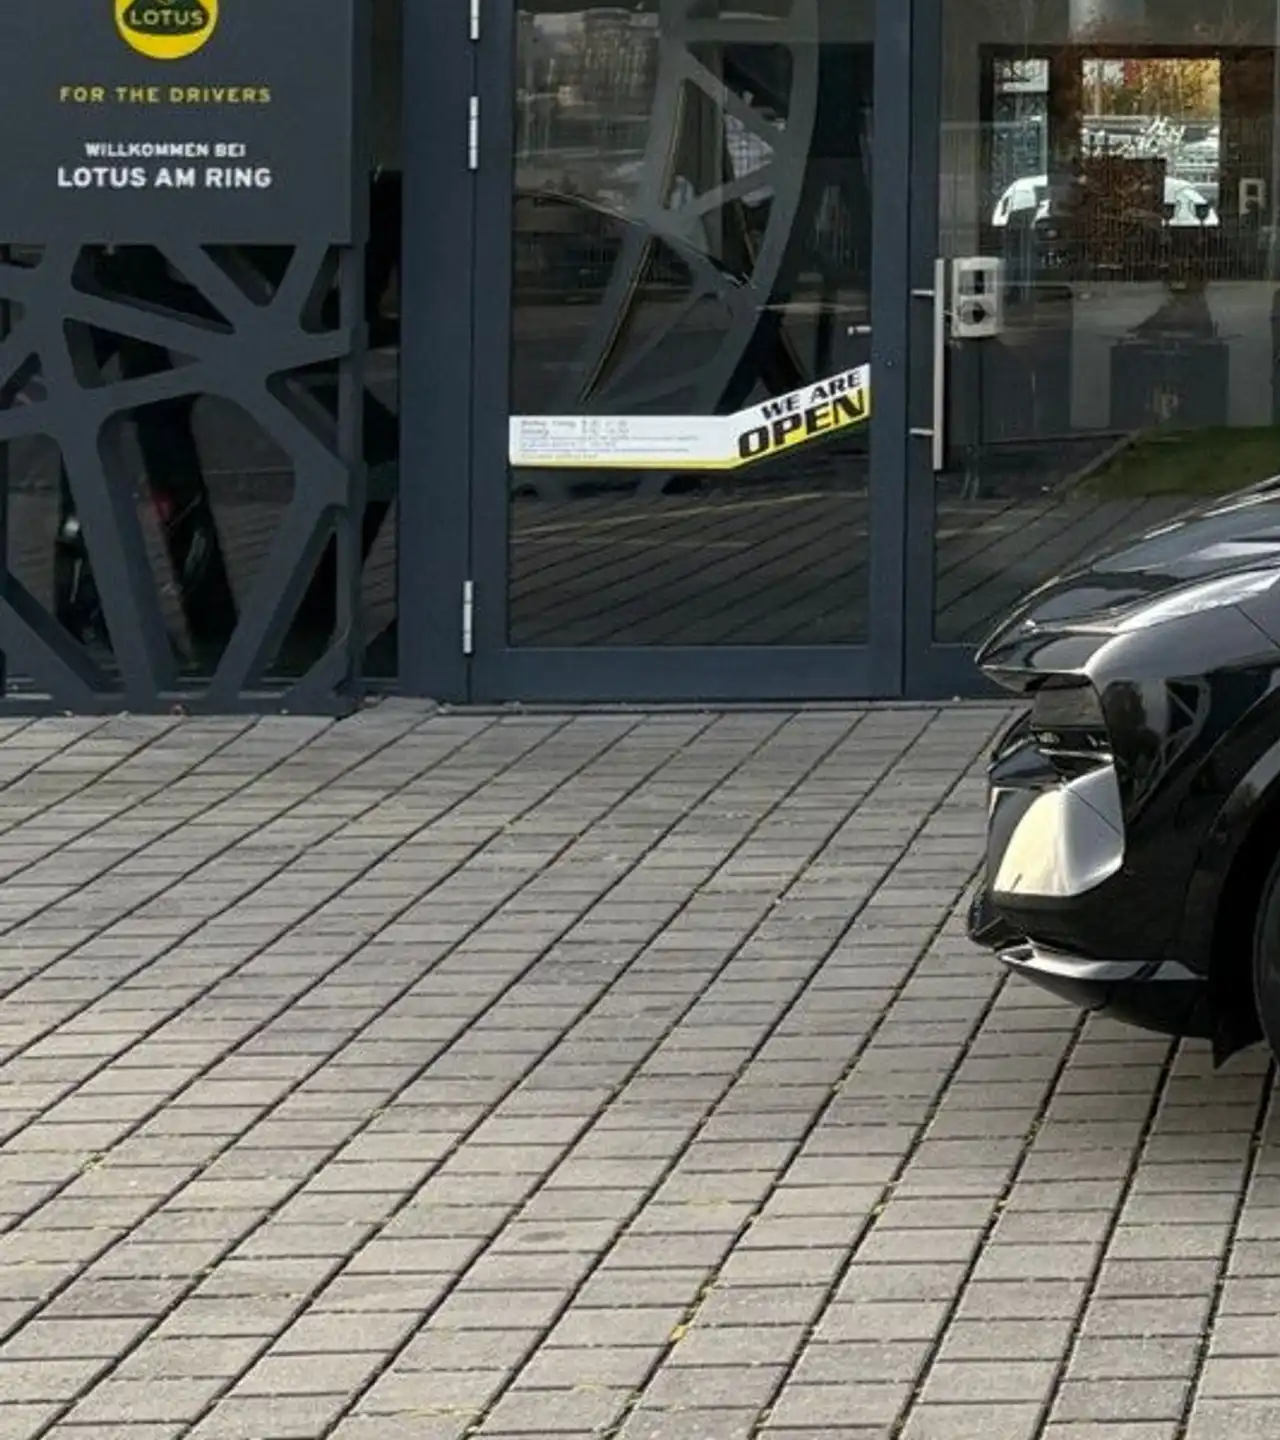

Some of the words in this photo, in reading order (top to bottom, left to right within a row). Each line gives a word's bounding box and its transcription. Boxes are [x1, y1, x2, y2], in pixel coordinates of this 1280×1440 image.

[130, 9, 203, 25] LOTUS
[60, 86, 105, 102] FOR
[115, 86, 160, 103] THE
[169, 86, 271, 103] DRIVERS
[84, 142, 209, 157] WILLKOMMEN
[214, 143, 246, 157] BEI
[57, 167, 147, 188] LOTUS
[154, 167, 196, 188] AM
[205, 167, 272, 188] RING
[761, 394, 801, 420] WE
[811, 371, 862, 402] ARE
[738, 388, 865, 459] OPEN
